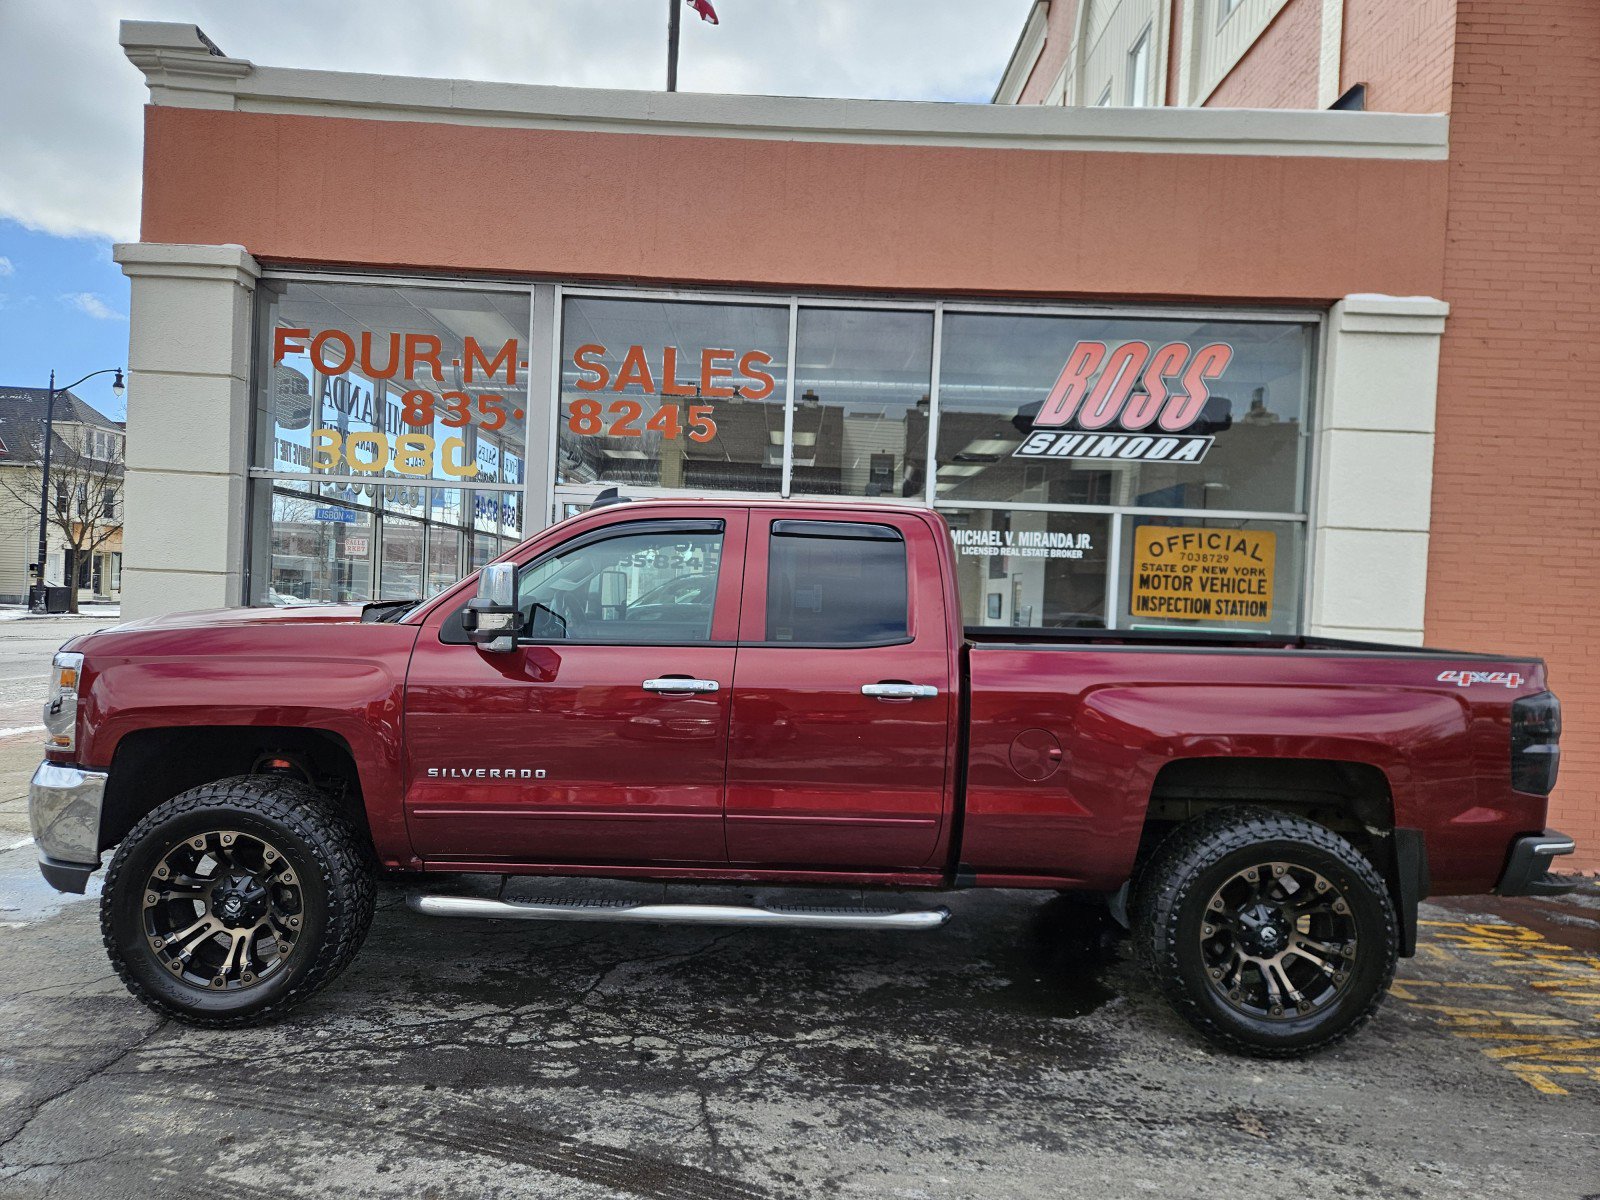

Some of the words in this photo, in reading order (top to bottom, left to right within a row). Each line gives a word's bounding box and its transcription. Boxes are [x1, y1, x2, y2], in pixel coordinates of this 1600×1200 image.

[572, 343, 776, 400] SALES
[1032, 339, 1235, 433] BOSS
[568, 398, 718, 442] 8245
[1021, 433, 1206, 461] SHINODA
[317, 511, 344, 521] LISBON
[950, 529, 1003, 547] MICHAEL
[1005, 531, 1015, 547] V.
[1018, 531, 1074, 548] MIRANDA
[1075, 534, 1094, 549] JR.
[1149, 533, 1263, 562] OFFICIAL
[962, 546, 999, 556] LICENSED
[1000, 547, 1021, 557] REAL
[1022, 548, 1049, 558] ESTATE
[1050, 549, 1084, 559] BROKER
[1180, 551, 1230, 564] 7038729
[1141, 563, 1177, 573] STATE
[1182, 564, 1198, 574] OF
[1202, 565, 1229, 575] NEW
[1234, 567, 1266, 577] YORK
[1139, 574, 1193, 592] MOTOR
[1199, 577, 1268, 596] VEHICLE
[1136, 595, 1212, 615] INSPECTION
[1215, 599, 1268, 618] STATION
[427, 767, 547, 779] SILVERADO
